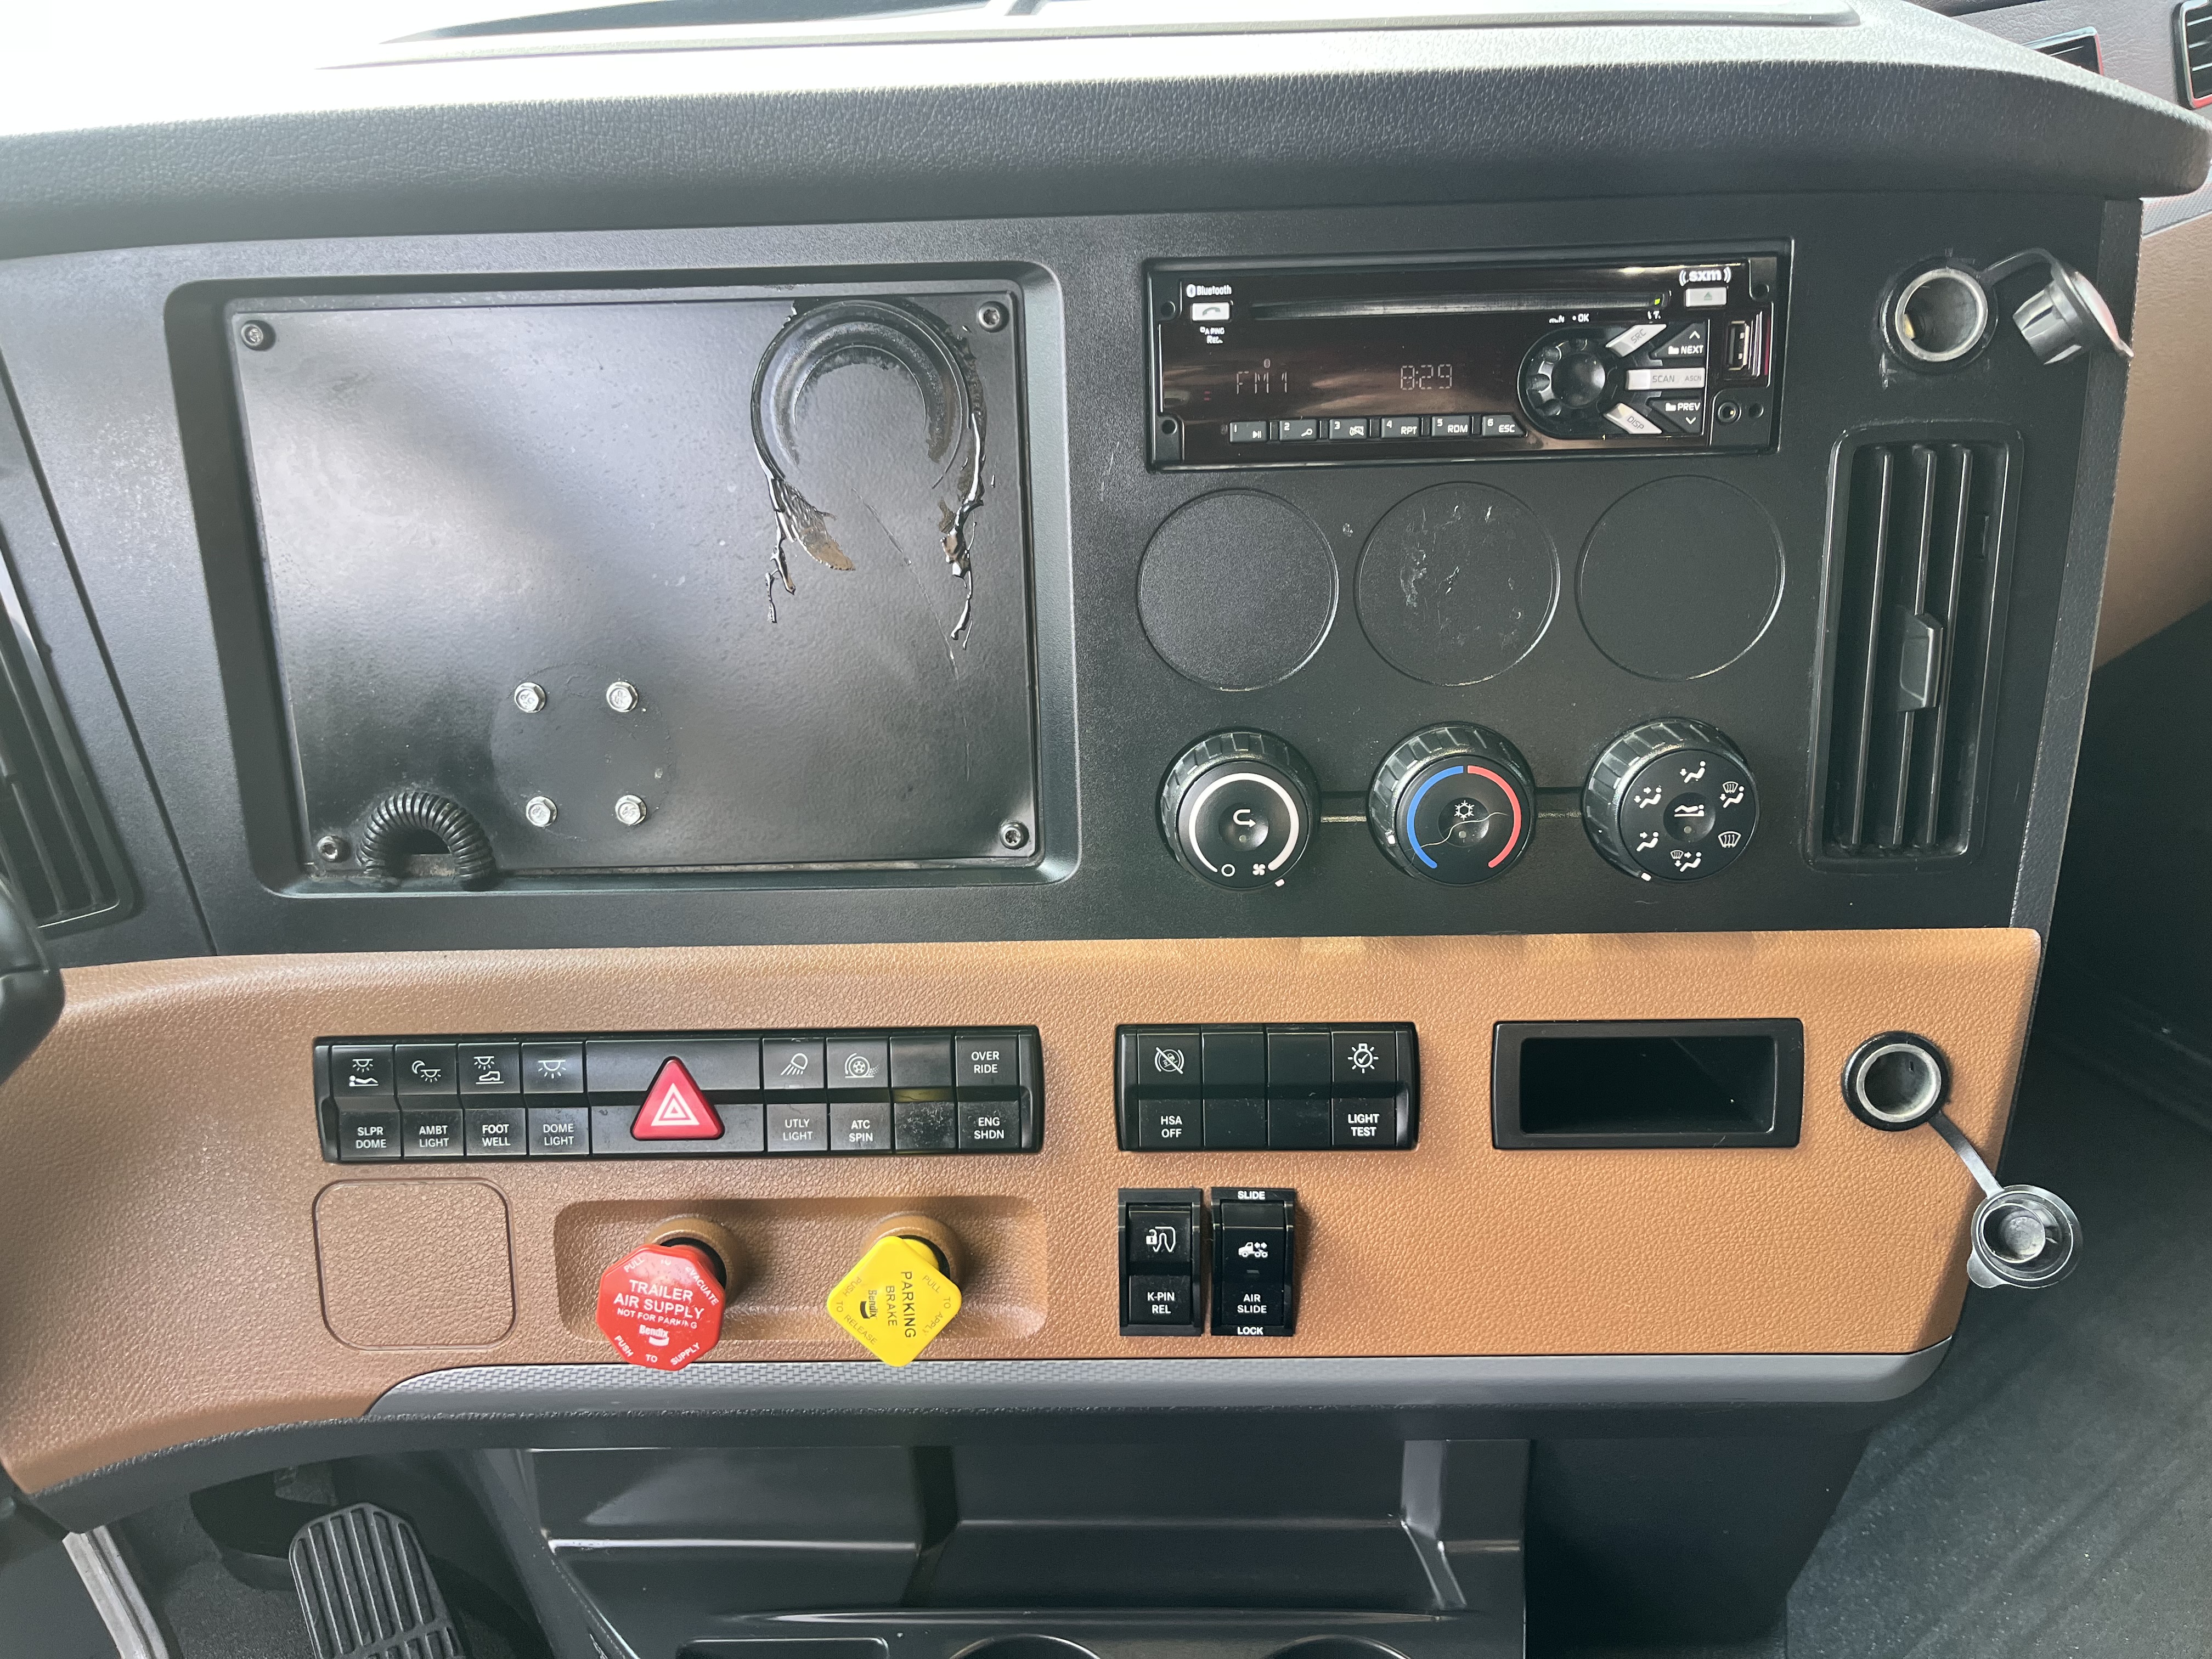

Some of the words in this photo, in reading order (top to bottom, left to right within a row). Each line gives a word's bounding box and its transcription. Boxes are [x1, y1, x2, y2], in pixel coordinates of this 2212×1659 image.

[1197, 285, 1232, 296] Bluetooth
[1578, 313, 1589, 323] OK
[1631, 329, 1646, 344] SRC
[1680, 345, 1704, 354] NEXT
[1400, 364, 1453, 391] 8:29
[1677, 402, 1701, 411] PREV
[1284, 422, 1290, 431] 2
[1334, 421, 1340, 430] 3
[1386, 420, 1392, 428] 4
[1437, 419, 1443, 427] 5
[1487, 418, 1494, 427] 6
[1627, 416, 1644, 430] DISP
[1401, 426, 1417, 435] RPT
[1447, 424, 1468, 433] RDM
[1498, 424, 1515, 433] ESC
[971, 1051, 1000, 1062] OVER
[974, 1064, 998, 1074] RIDE
[785, 1119, 810, 1128] UTLY
[978, 1117, 1000, 1127] ENG
[1160, 1115, 1183, 1126] HSA
[1347, 1114, 1380, 1124] LIGHT
[419, 1125, 448, 1135] AMBT
[482, 1124, 509, 1135] FOOT
[543, 1124, 574, 1134] DOME
[850, 1120, 871, 1130] ATC
[357, 1126, 383, 1136] SLPR
[783, 1131, 814, 1141] LIGHT
[974, 1129, 1005, 1140] SHDN
[1161, 1128, 1182, 1138] OFF
[1351, 1126, 1377, 1137] TEST
[481, 1136, 511, 1147] WELL
[544, 1136, 574, 1147] LIGHT
[848, 1132, 873, 1142] SPIN
[356, 1139, 387, 1149] DOME
[419, 1138, 449, 1148] LIGHT
[1237, 1190, 1266, 1200] SLIDE
[624, 1257, 645, 1272] PULL
[685, 1266, 719, 1306] EVACUATE
[922, 1275, 940, 1294] PULL
[629, 1279, 693, 1301] TRAILER
[843, 1277, 862, 1297] PUSH
[1147, 1292, 1175, 1302] K-PIN
[1243, 1294, 1261, 1303] AIR
[613, 1293, 639, 1308] AIR
[644, 1299, 704, 1319] SUPPLY
[836, 1301, 843, 1312] TO
[868, 1290, 878, 1319] Bendix
[886, 1285, 898, 1327] BRAKE
[901, 1271, 916, 1338] PARKING
[944, 1296, 951, 1309] TO
[1152, 1304, 1171, 1314] REL
[1237, 1304, 1267, 1314] SLIDE
[617, 1308, 636, 1318] NOT
[637, 1312, 656, 1322] FOR
[922, 1312, 943, 1334] APPLY
[639, 1324, 669, 1338] Bendix
[844, 1314, 877, 1345] RELEASE
[1237, 1326, 1263, 1335] LOCK
[614, 1335, 634, 1357] PUSH
[645, 1353, 658, 1363] TO
[670, 1342, 701, 1365] SUPPLY
